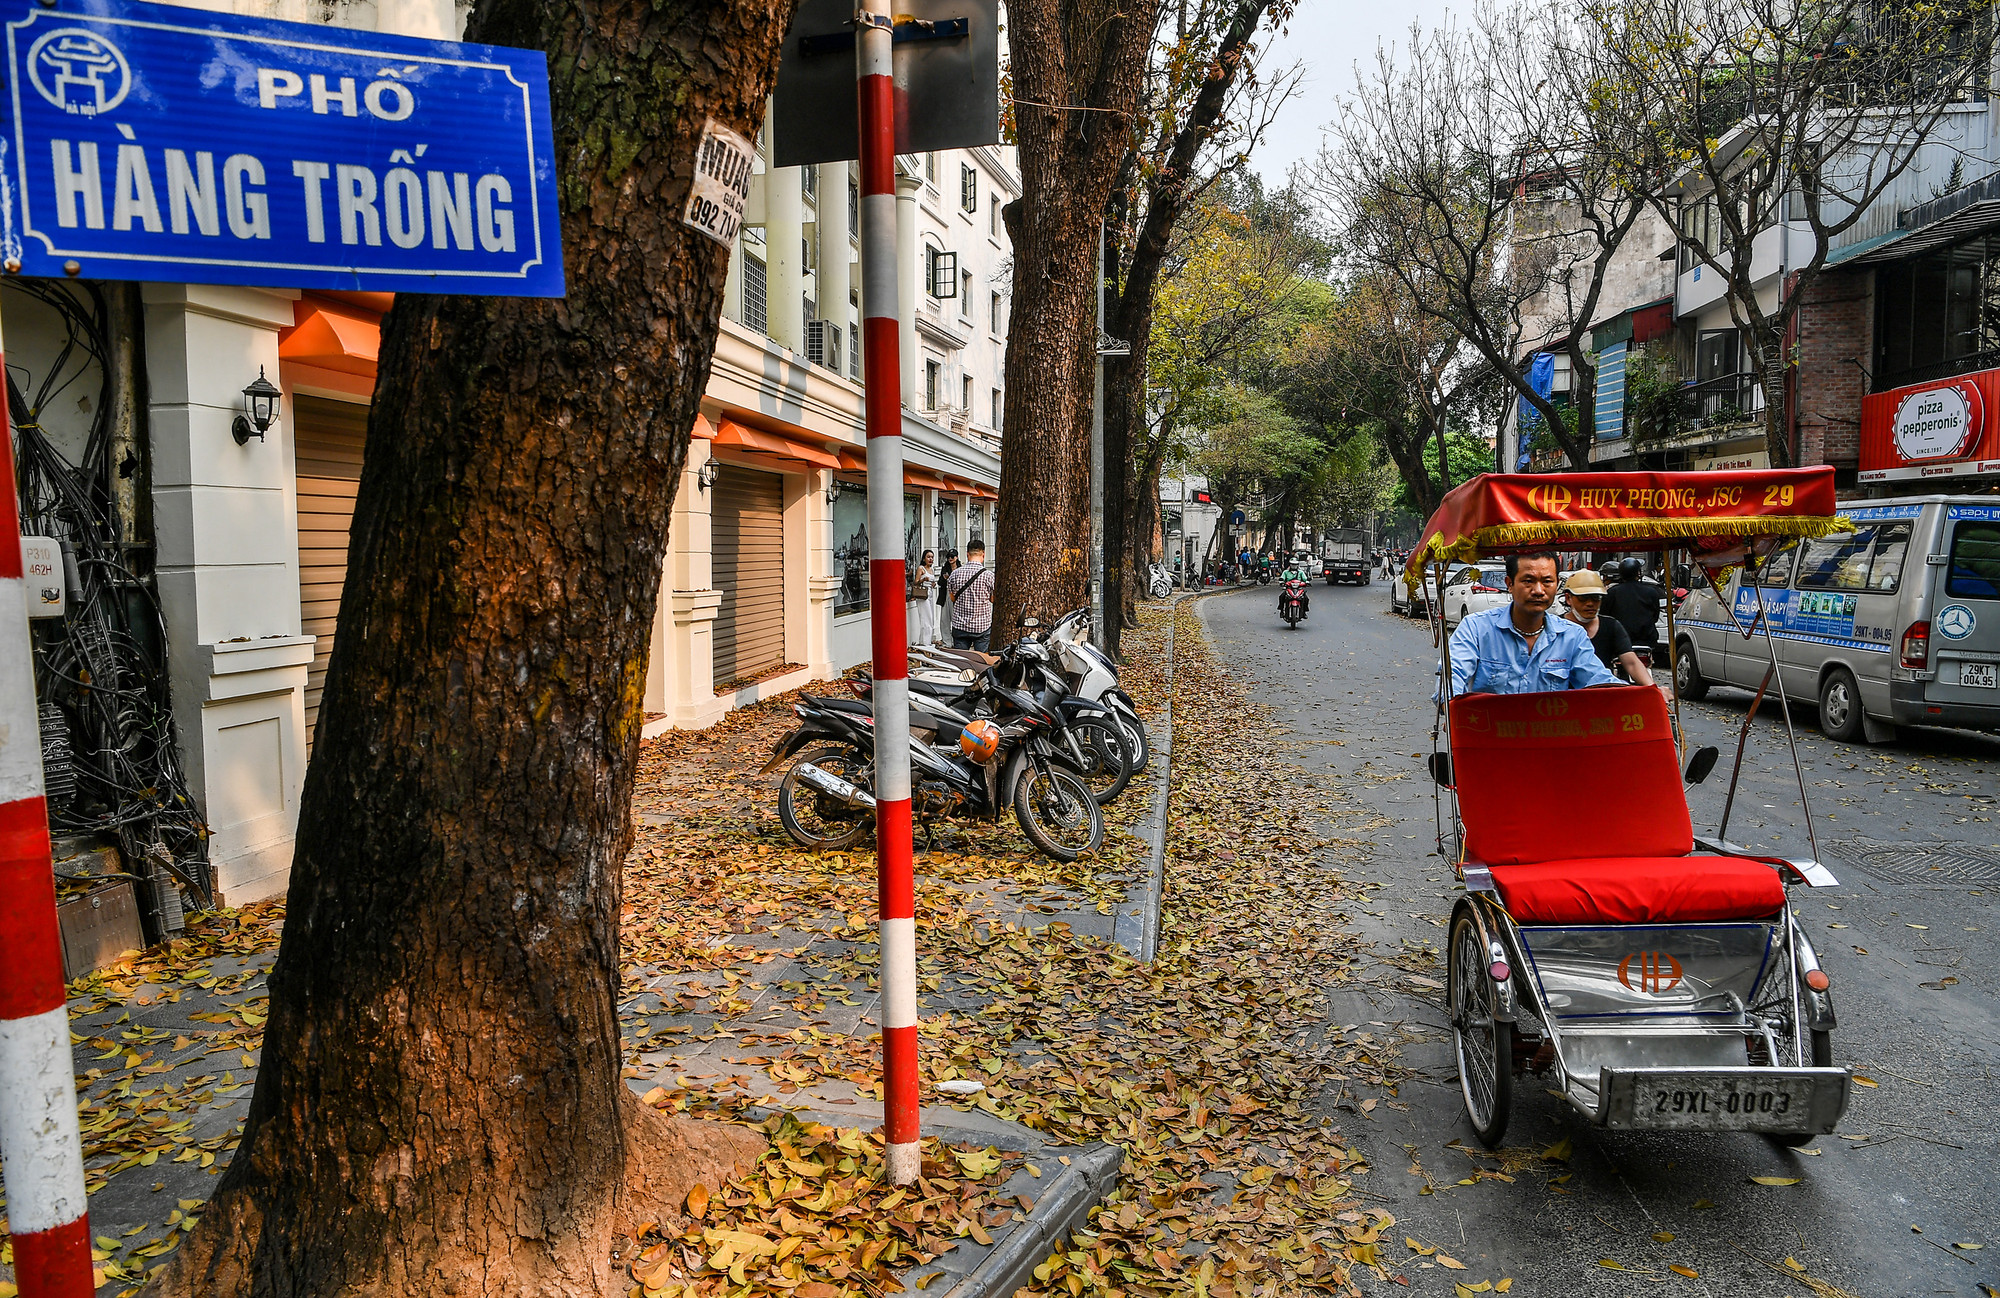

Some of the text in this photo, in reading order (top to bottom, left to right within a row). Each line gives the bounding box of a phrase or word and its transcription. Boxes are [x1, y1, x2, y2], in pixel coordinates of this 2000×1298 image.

[257, 65, 415, 121] PHỐ
[66, 99, 79, 115] HÀ
[51, 123, 516, 253] HÀNG TRỐNG
[690, 195, 719, 231] 092
[1917, 400, 1943, 420] pizza
[1902, 413, 1958, 439] pepperonis
[1579, 488, 1622, 509] HUY
[1707, 485, 1743, 507] JSC
[1763, 484, 1794, 507] 29
[1960, 508, 1989, 518] sapy
[27, 547, 50, 560] P310
[30, 564, 52, 576] 462H
[1772, 601, 1787, 615] SAPY
[1968, 664, 1990, 676] 29KT
[1963, 674, 1993, 687] 004.95
[1621, 713, 1645, 732] 29
